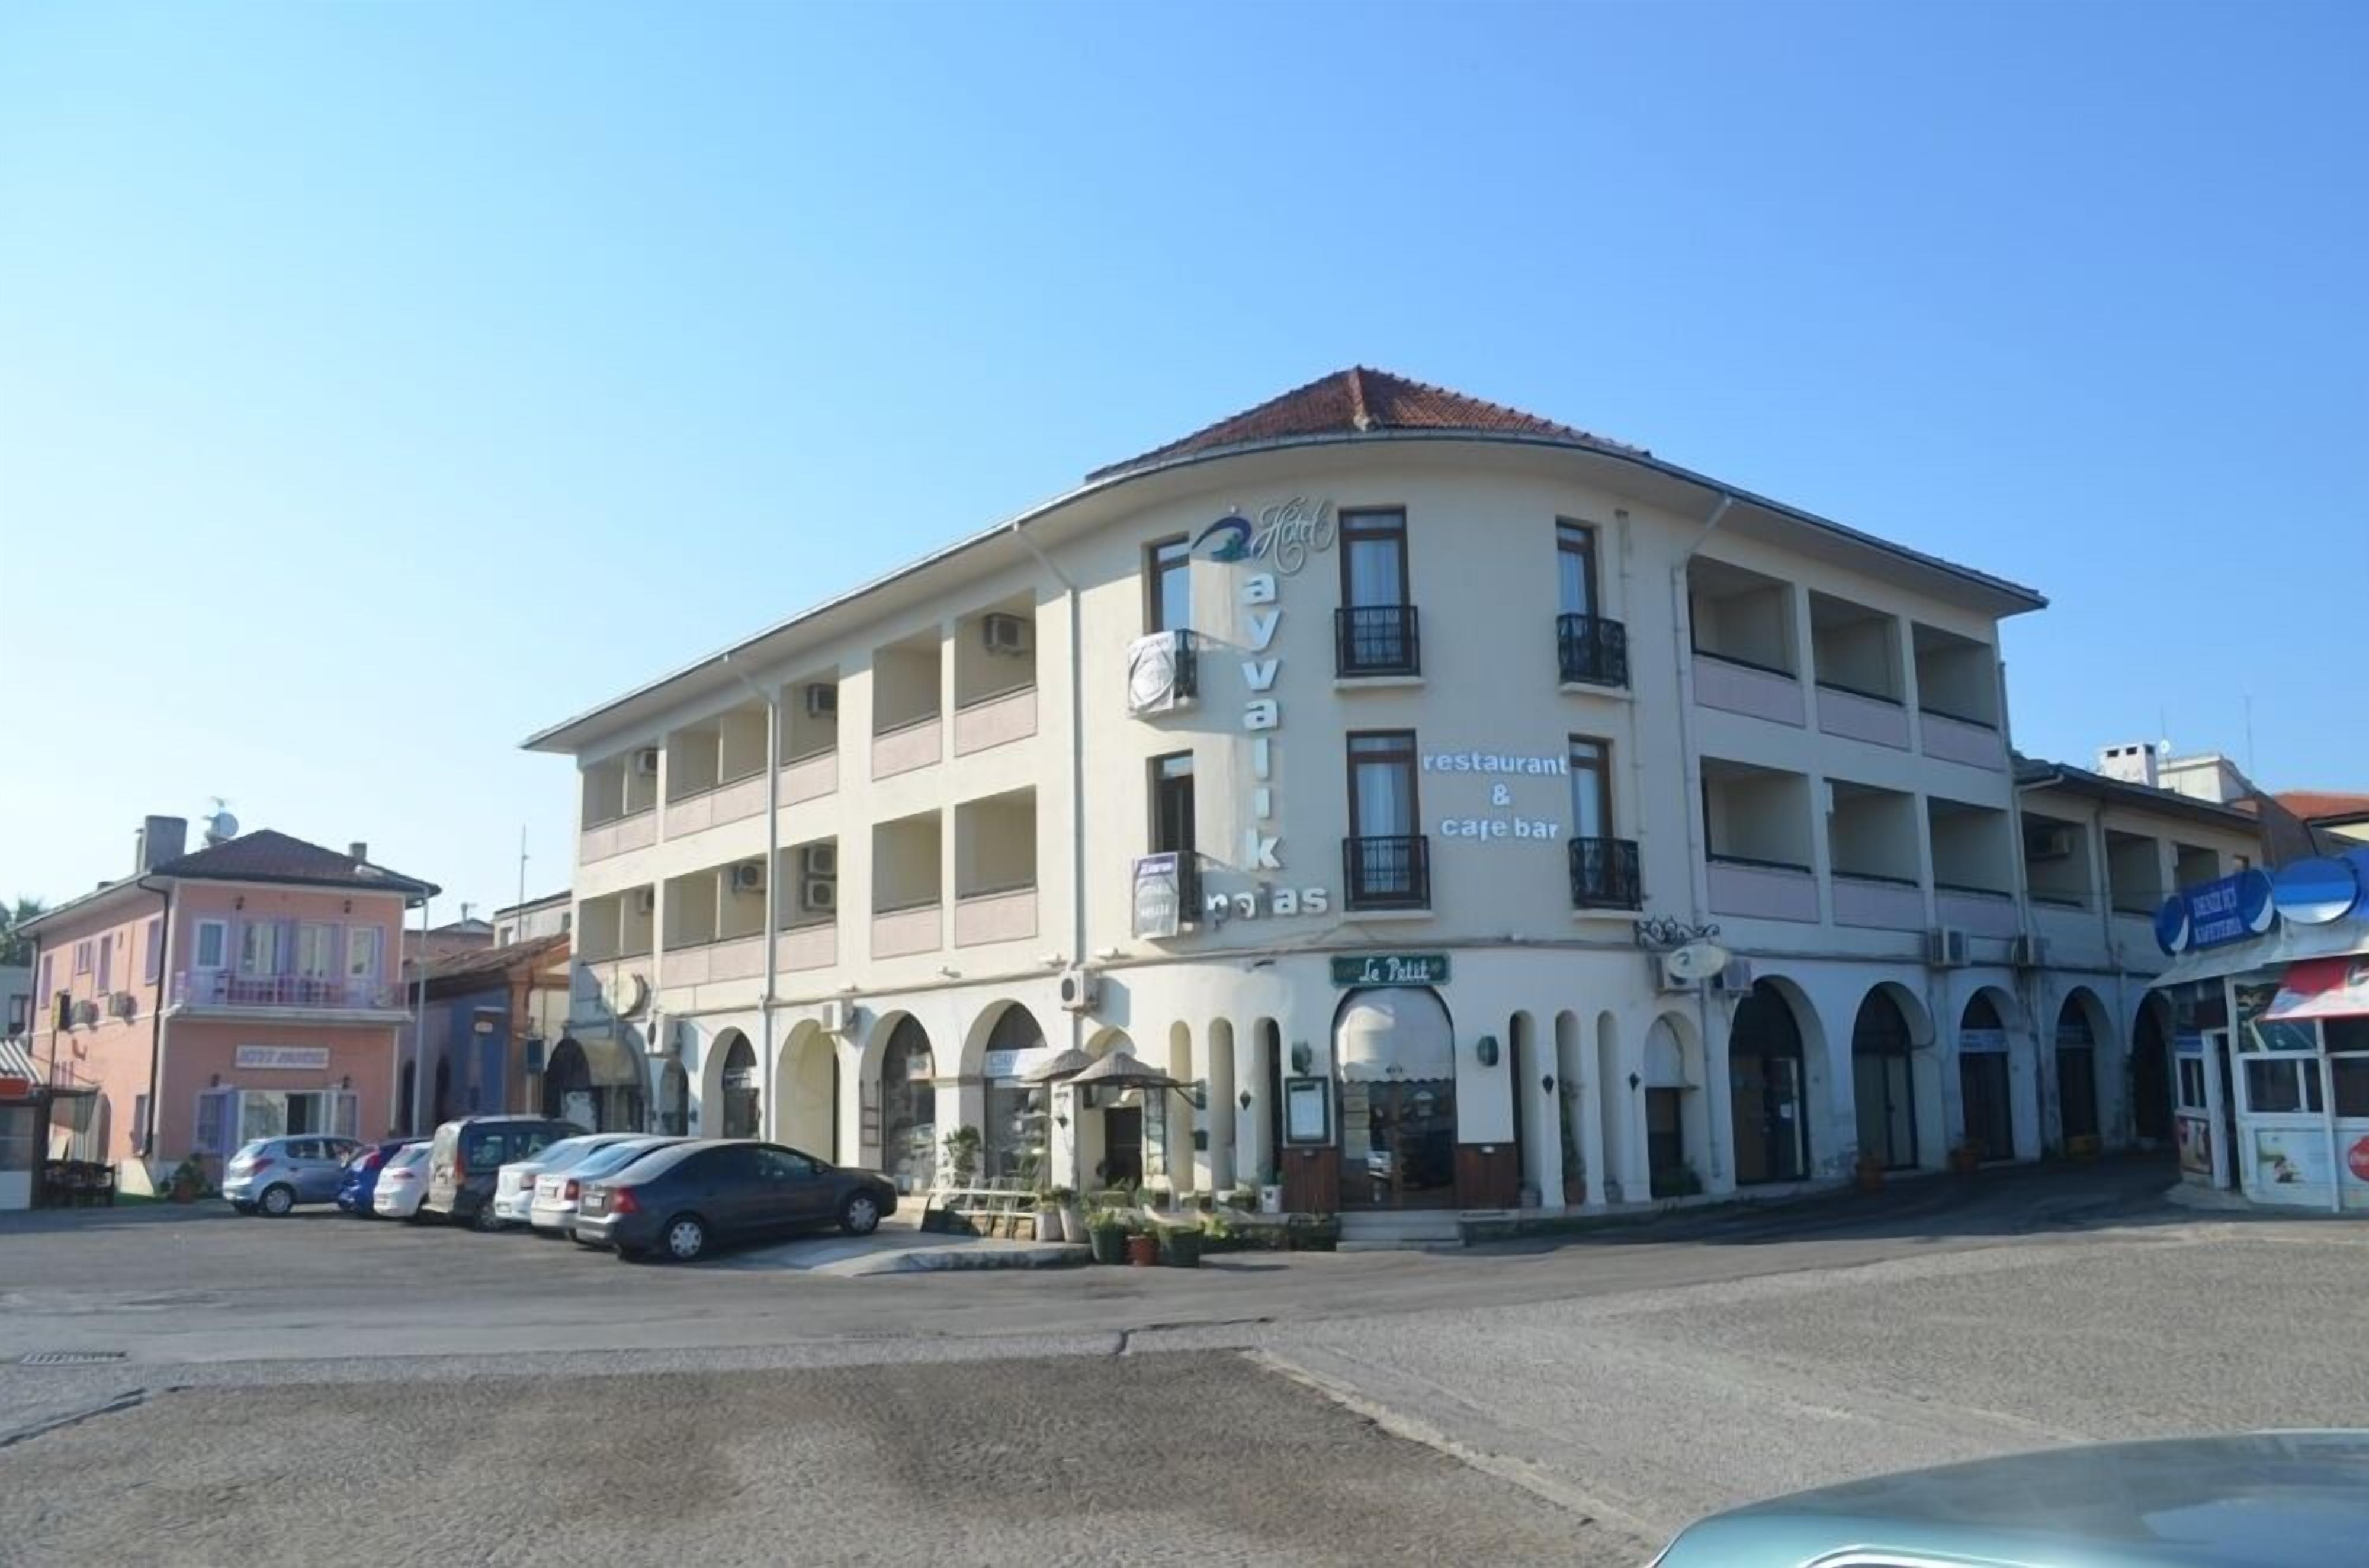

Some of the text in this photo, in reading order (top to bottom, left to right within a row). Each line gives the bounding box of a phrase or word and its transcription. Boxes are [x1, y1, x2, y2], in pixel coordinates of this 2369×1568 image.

[1423, 751, 1568, 775] restaurant
[1492, 783, 1510, 805] &
[1514, 817, 1559, 839] bar
[1359, 957, 1430, 983] Le Petit
